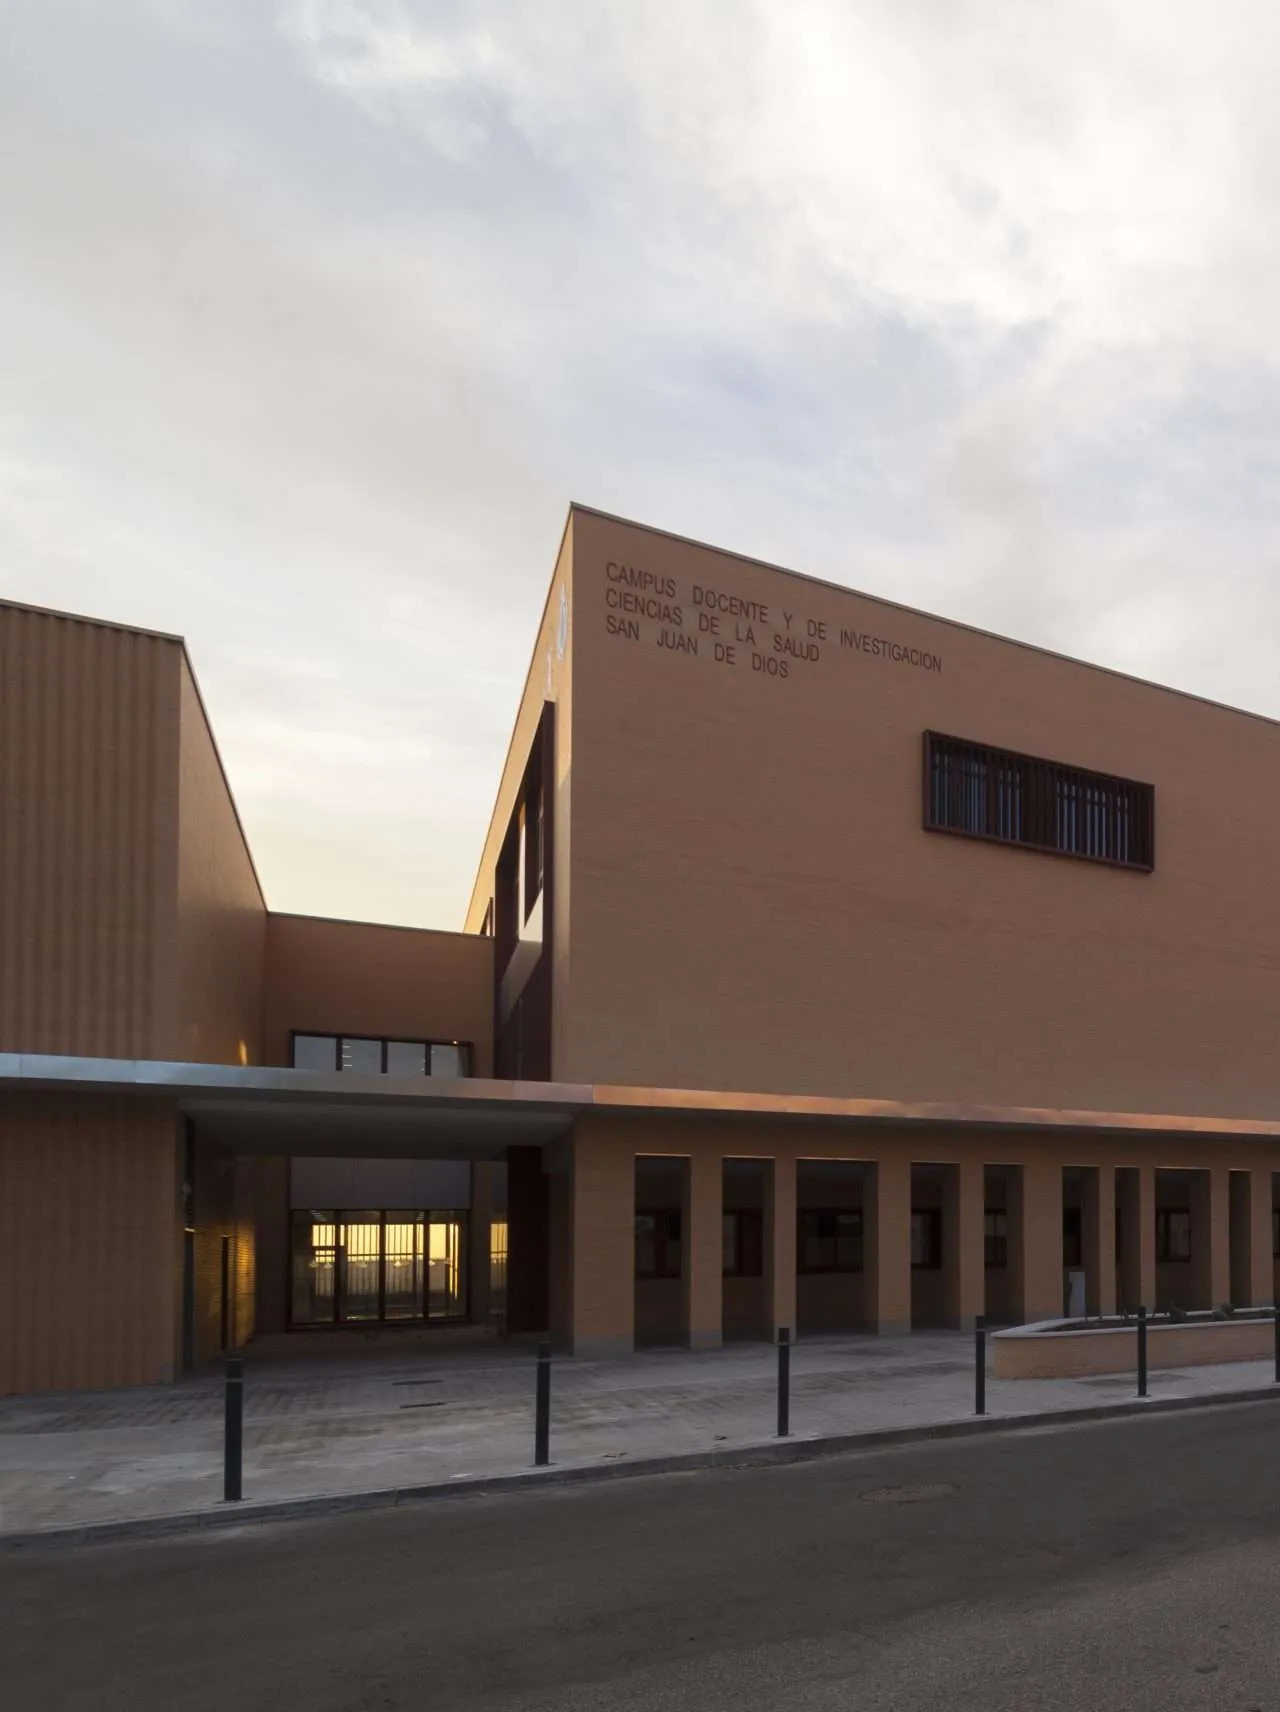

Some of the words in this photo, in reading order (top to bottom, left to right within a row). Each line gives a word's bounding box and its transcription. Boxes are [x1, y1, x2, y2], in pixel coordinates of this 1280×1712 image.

[606, 561, 676, 598] CAMPUS
[693, 585, 769, 624] DOCENTE
[783, 612, 794, 630] Y
[807, 619, 828, 641] DE
[840, 629, 943, 673] INVESTIGACION
[606, 588, 683, 627] CIENCIAS
[699, 613, 721, 636] DE
[736, 622, 756, 646] LA
[773, 634, 820, 663] SALUD
[606, 614, 641, 641] SAN
[657, 629, 699, 656] JUAN
[714, 643, 736, 665] DE
[752, 652, 789, 679] DIOS
